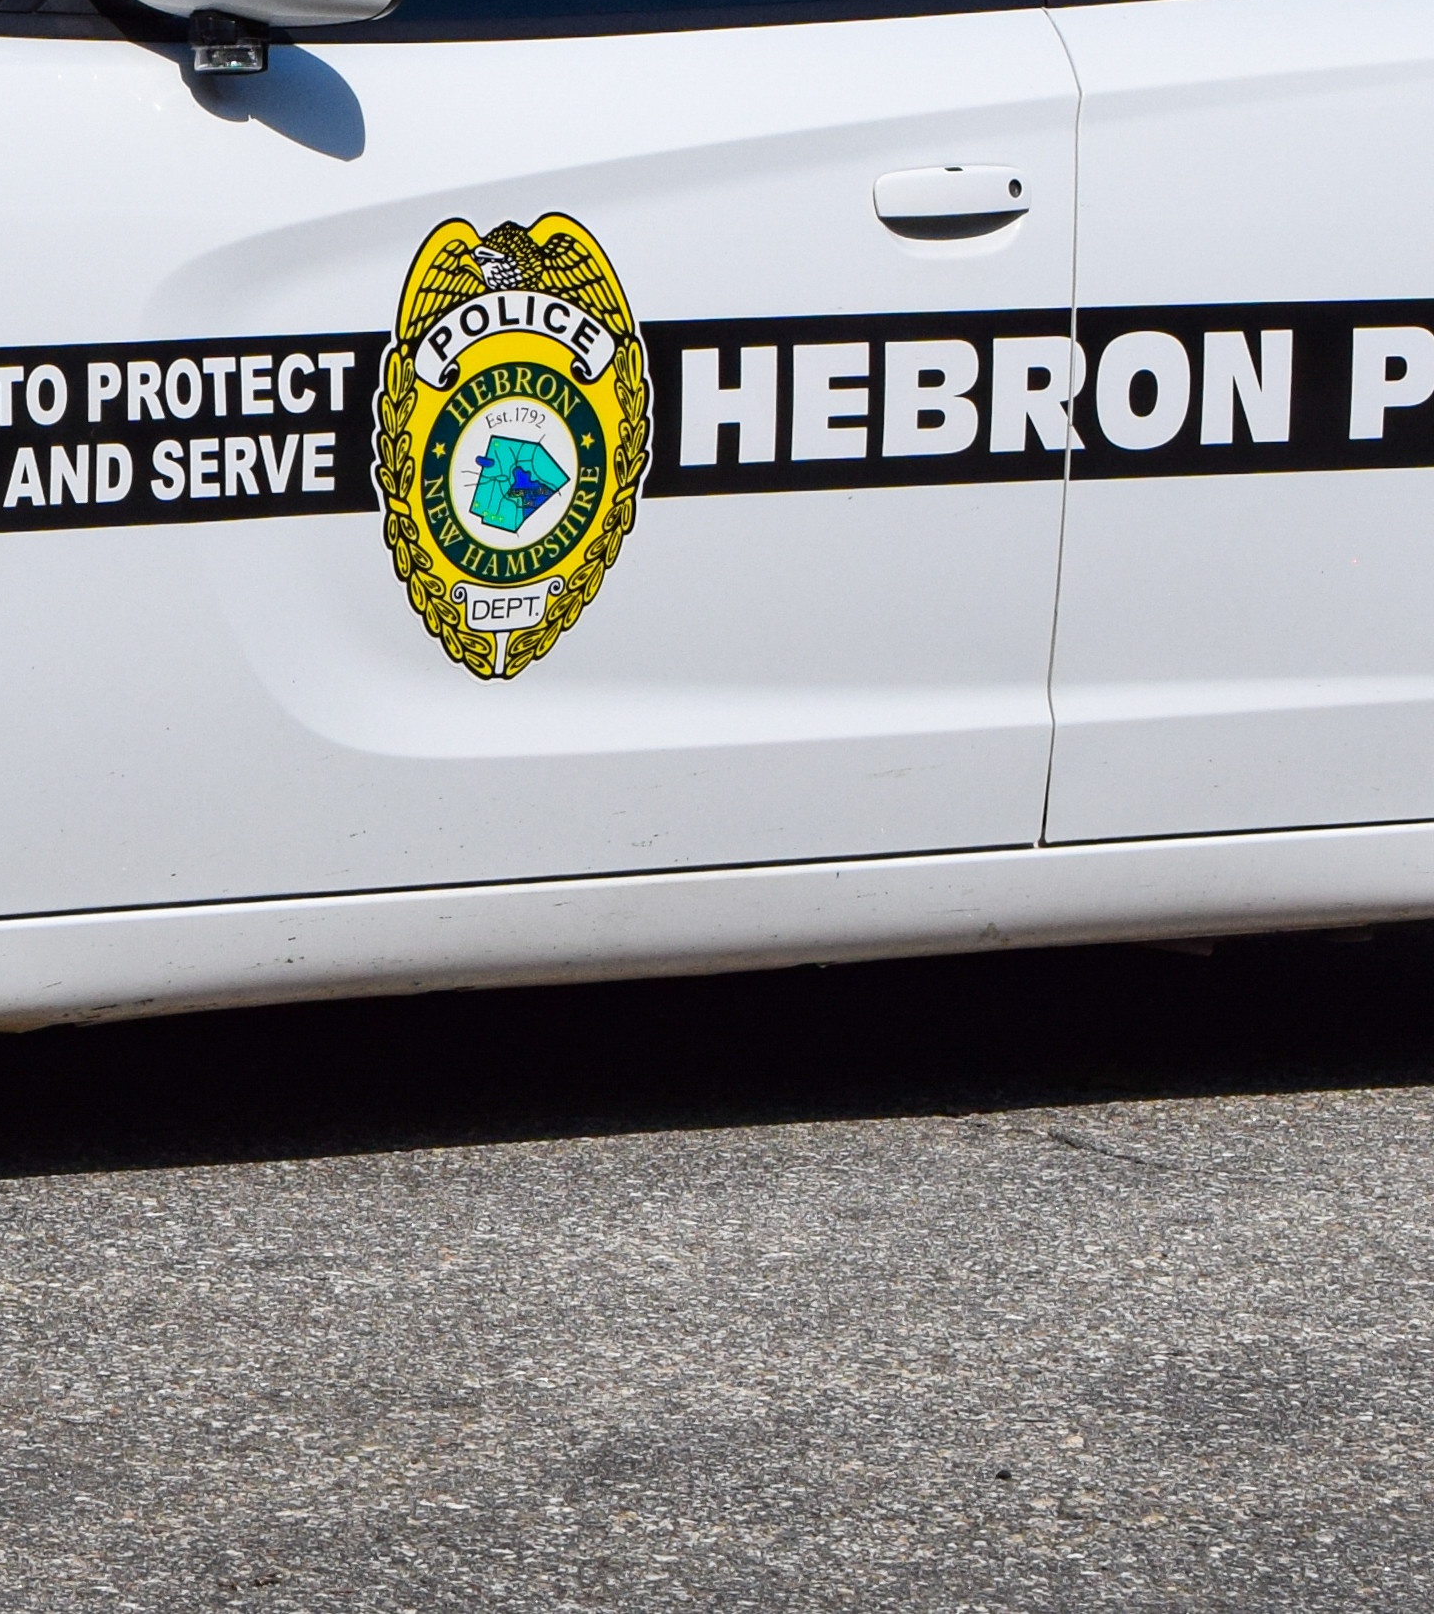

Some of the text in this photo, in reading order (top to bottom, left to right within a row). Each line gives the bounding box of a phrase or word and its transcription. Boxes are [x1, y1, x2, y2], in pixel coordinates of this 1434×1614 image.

[428, 295, 600, 362] POLICE
[87, 352, 355, 423] PROTECT
[446, 366, 580, 426] HEBRON
[485, 406, 546, 430] Est. 1792
[679, 328, 1295, 467] HEBRON
[2, 432, 336, 508] AND SERVE
[424, 464, 600, 578] NEW HAMPSHIRE
[472, 595, 541, 622] DEPT.
